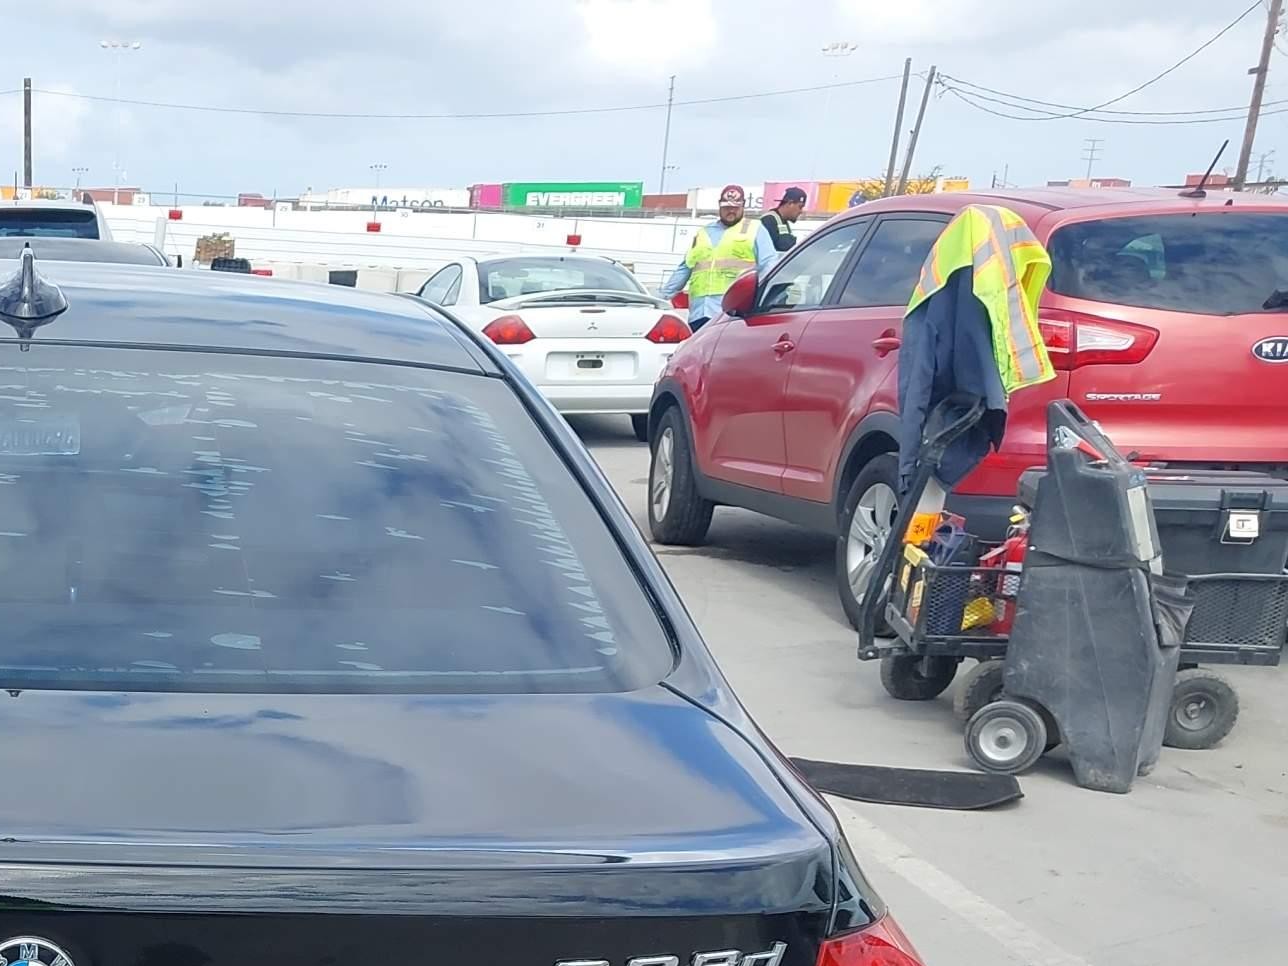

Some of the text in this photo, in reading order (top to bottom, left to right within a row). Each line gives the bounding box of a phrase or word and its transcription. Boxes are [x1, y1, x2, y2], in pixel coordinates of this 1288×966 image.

[371, 195, 444, 208] Matson
[526, 192, 626, 206] EVERGREEN
[1086, 393, 1161, 401] SPORTAGE
